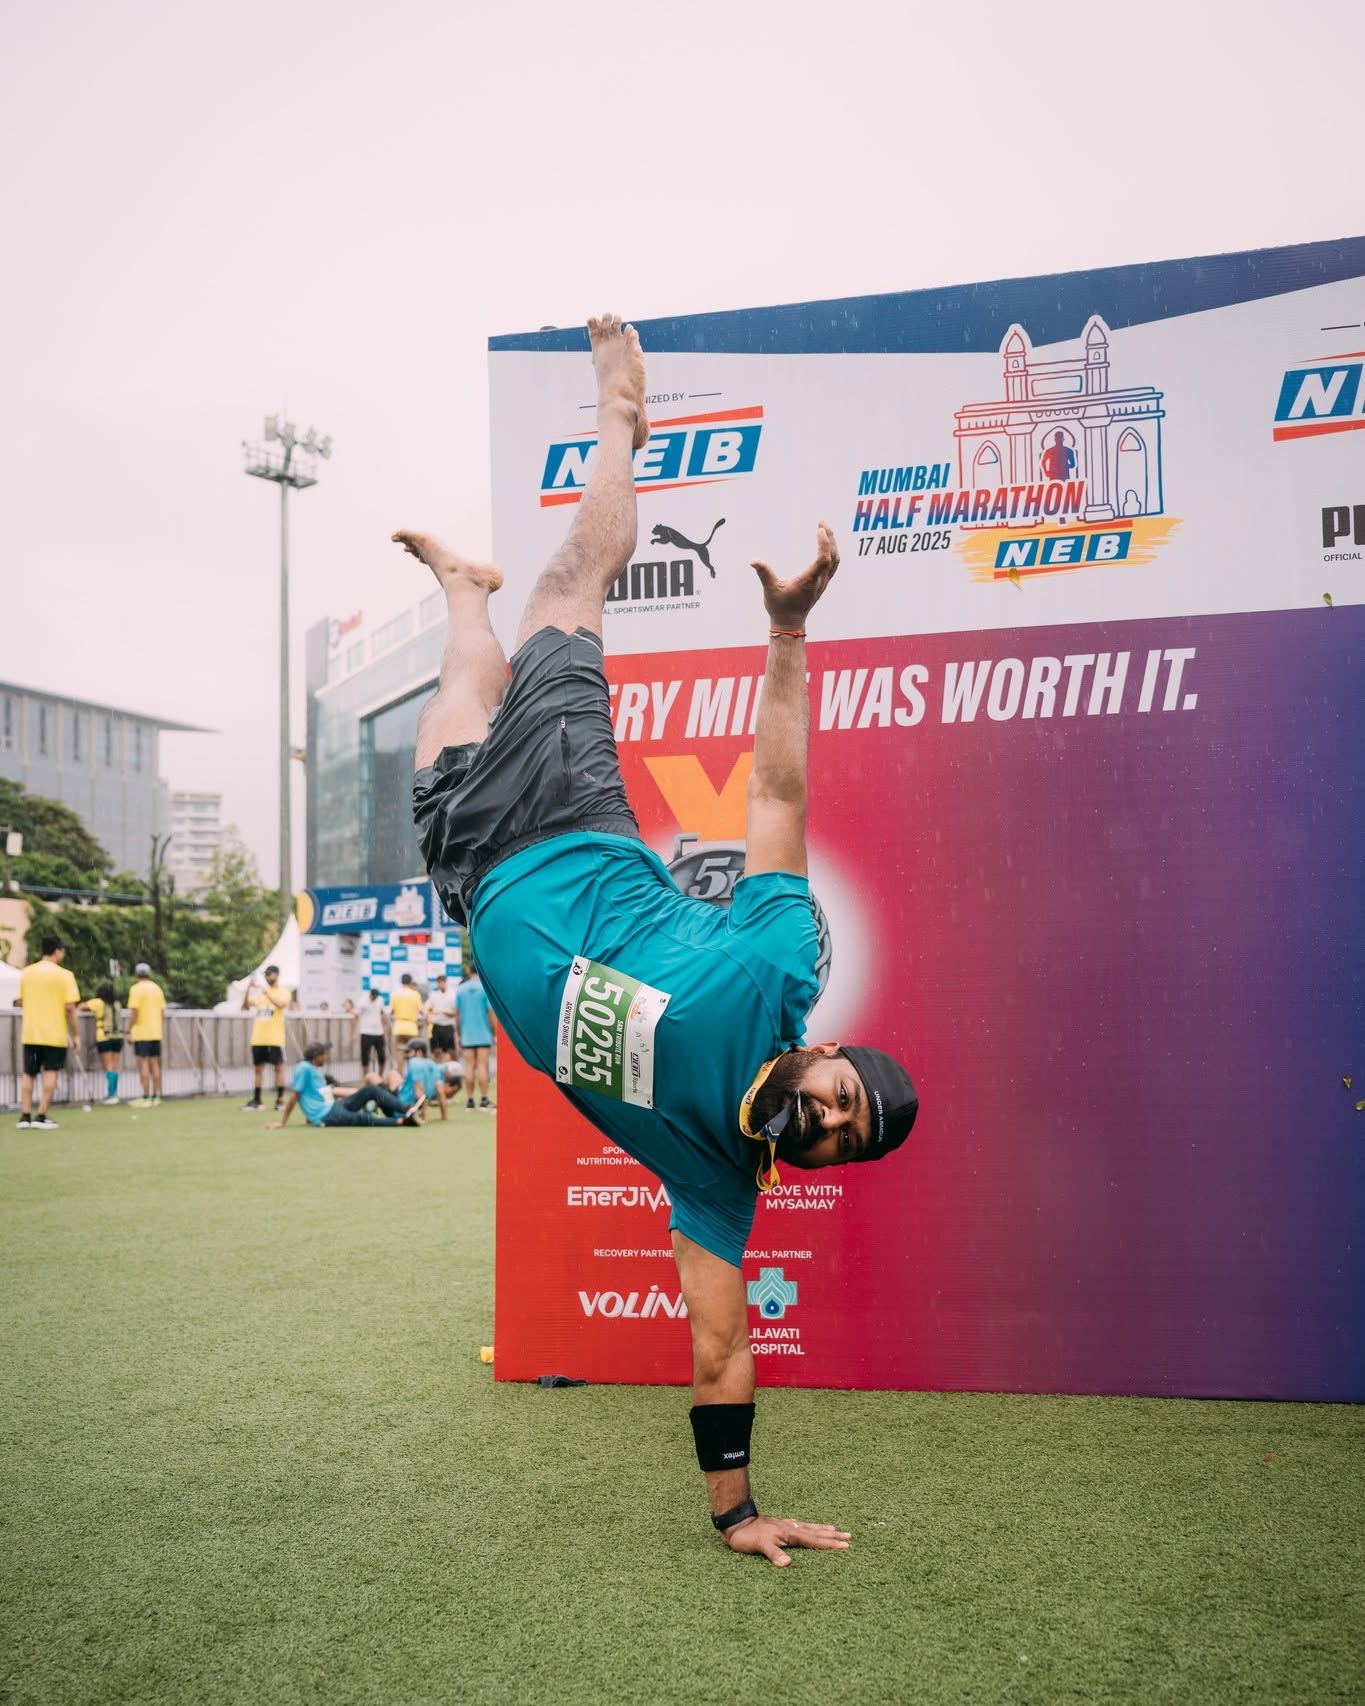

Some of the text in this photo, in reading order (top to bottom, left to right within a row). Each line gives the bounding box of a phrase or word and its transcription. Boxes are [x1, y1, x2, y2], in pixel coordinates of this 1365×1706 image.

[672, 392, 685, 401] BY
[857, 463, 951, 496] MUMBAI
[852, 480, 1085, 533] HALF MARATHON
[858, 530, 952, 557] 17 AUG 2025
[1000, 534, 1121, 567] NEB
[1323, 552, 1363, 562] OFFICIAL
[606, 559, 694, 602] UMA
[613, 604, 665, 614] SPORTSWEAR
[666, 602, 701, 611] PARTNER
[818, 664, 930, 731] WAS
[941, 651, 1131, 724] WORTH
[1137, 647, 1199, 713] IT.
[561, 1001, 573, 1047] ARVIND SHINDE
[574, 976, 625, 1086] 50255
[615, 1033, 623, 1054] TRIBUTE
[873, 1090, 884, 1115] UNDER
[576, 1157, 622, 1166] NUTRITION
[805, 1185, 843, 1196] WITH
[766, 1198, 836, 1210] MYSAMAY
[593, 1248, 674, 1258] RECOVERY PARTNE
[742, 1250, 812, 1259] DICAL PARTNER
[748, 1327, 800, 1339] ILAVATI
[750, 1343, 806, 1355] OSPITAL
[723, 1450, 745, 1460] omtex
